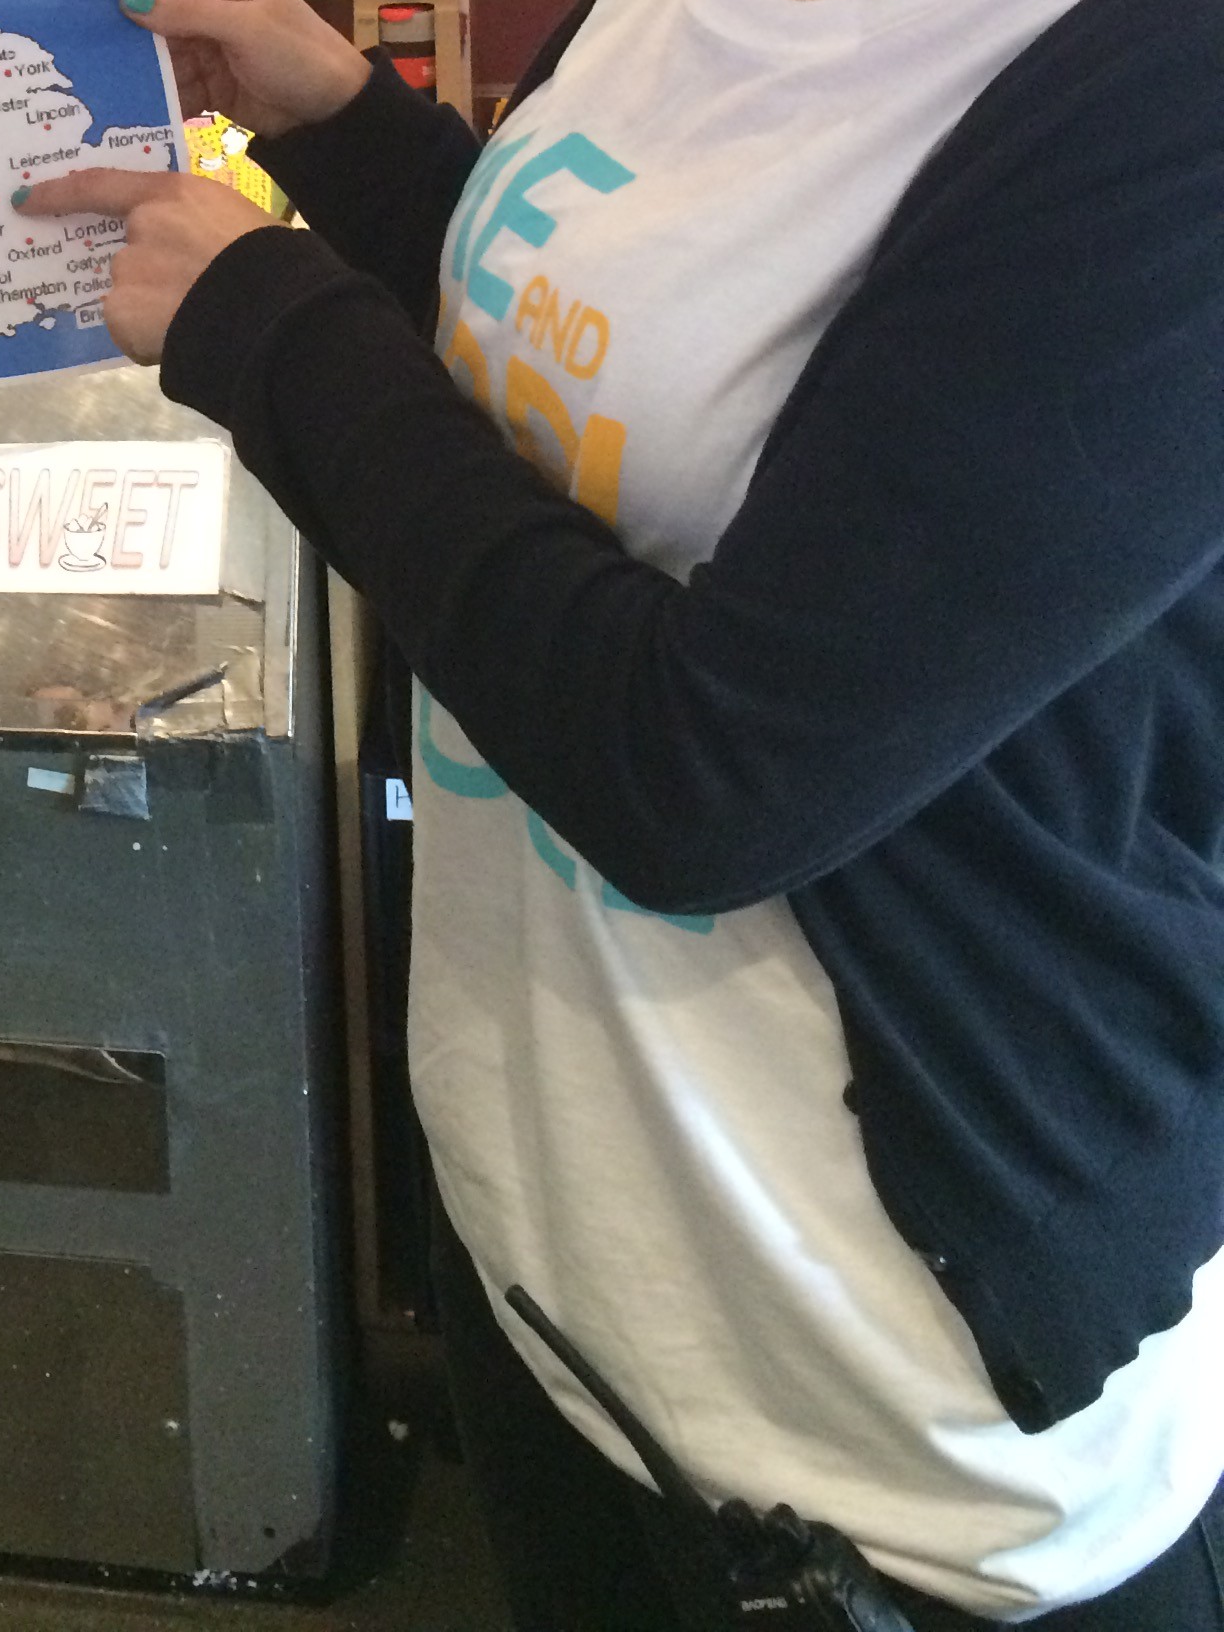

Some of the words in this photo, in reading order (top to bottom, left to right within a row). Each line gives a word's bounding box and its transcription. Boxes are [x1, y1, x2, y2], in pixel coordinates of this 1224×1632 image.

[14, 61, 52, 76] York
[26, 104, 80, 125] Lincoln
[108, 128, 174, 149] Norwich
[9, 146, 82, 169] Leicester
[7, 240, 63, 263] Oxford
[514, 274, 610, 381] AND
